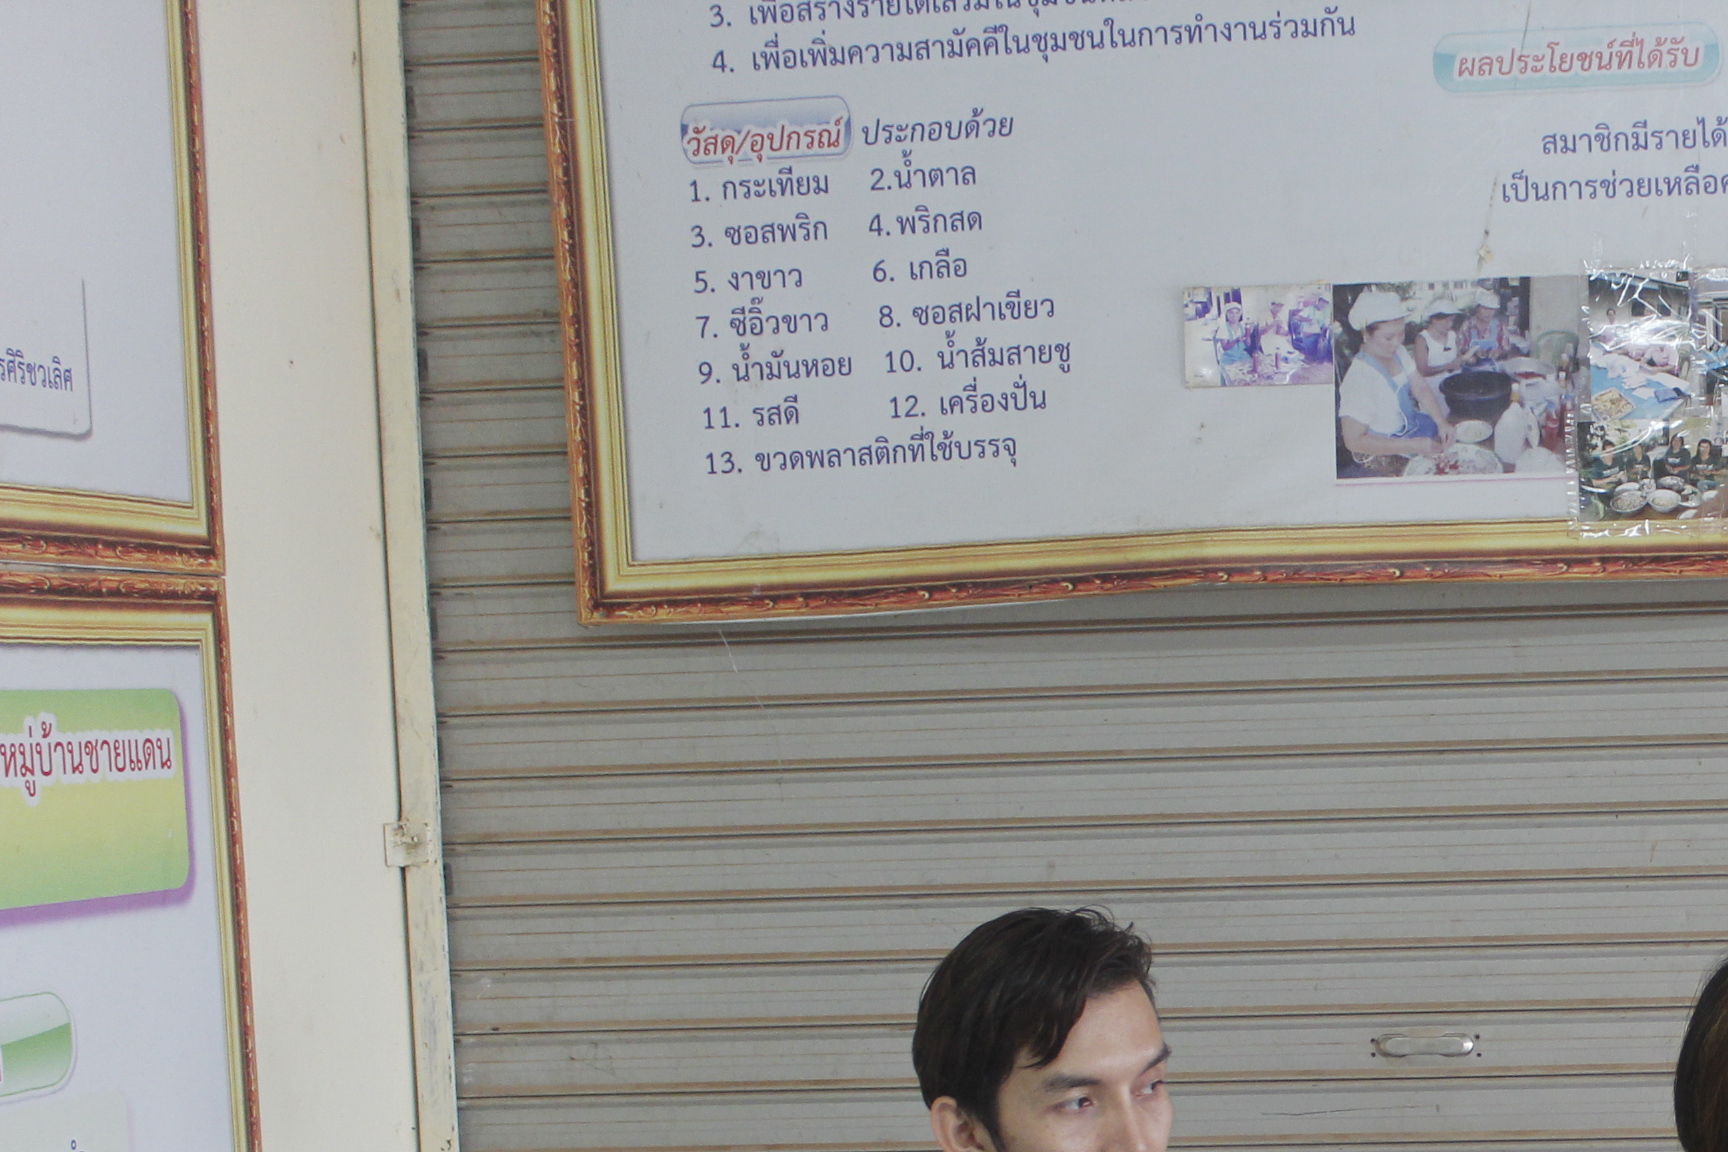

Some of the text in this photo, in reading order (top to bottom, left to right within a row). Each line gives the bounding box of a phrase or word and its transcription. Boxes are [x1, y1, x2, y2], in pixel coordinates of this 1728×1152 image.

[709, 3, 732, 28] 3.
[711, 6, 1357, 73] 4. เพื่อเพิ่มความสามัคคีในชุมชนในการทำงานร่วมกัน
[1457, 31, 1702, 78] ผลประโยชน์ที่ได้รับ
[686, 107, 1014, 164] วัสดุ/อุปกรณ์ ประกอบด้วย
[689, 165, 829, 203] 1. กระเทียม
[690, 212, 828, 249] 3. ซอสพริก
[693, 267, 803, 294] 5. งาขาว
[872, 247, 968, 283] 6. เกลือ
[695, 296, 829, 339] 7. ซีอิ๊วขาว
[878, 288, 1055, 329] 8. ซอสฝาเขียว
[698, 342, 852, 385] 9. น้ำมันหอย
[885, 329, 1071, 377] 10. น้ำส้มสายชู
[703, 394, 800, 430] 11. รสดี
[889, 374, 1047, 419] 12. เครื่องปั่น
[705, 423, 1017, 475] 13. ขวดพลาสติกที่ใช้บรรจุ
